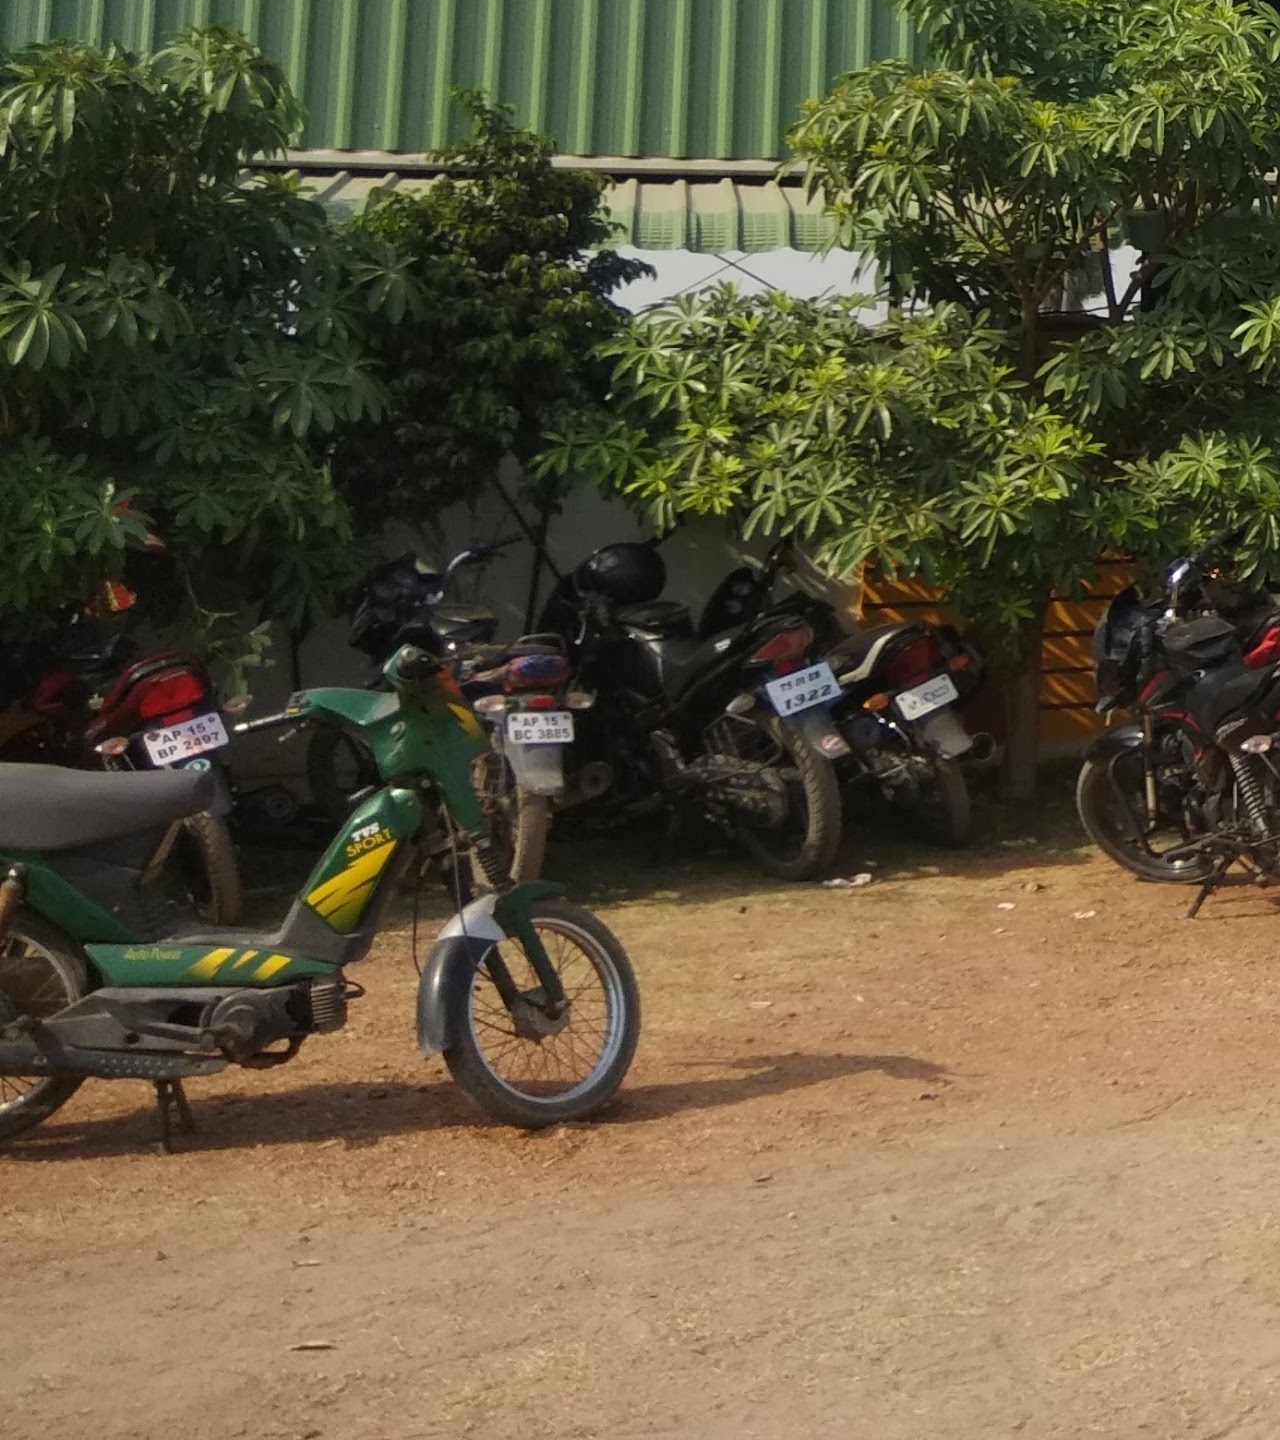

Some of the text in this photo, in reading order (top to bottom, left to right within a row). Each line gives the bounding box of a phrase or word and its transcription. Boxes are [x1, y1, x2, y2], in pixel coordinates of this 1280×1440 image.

[784, 684, 832, 711] 1322
[523, 716, 558, 727] AP 15
[156, 731, 219, 759] BP 2497
[162, 723, 206, 745] AP 15
[346, 827, 392, 857] SPORT
[351, 822, 380, 842] TVS
